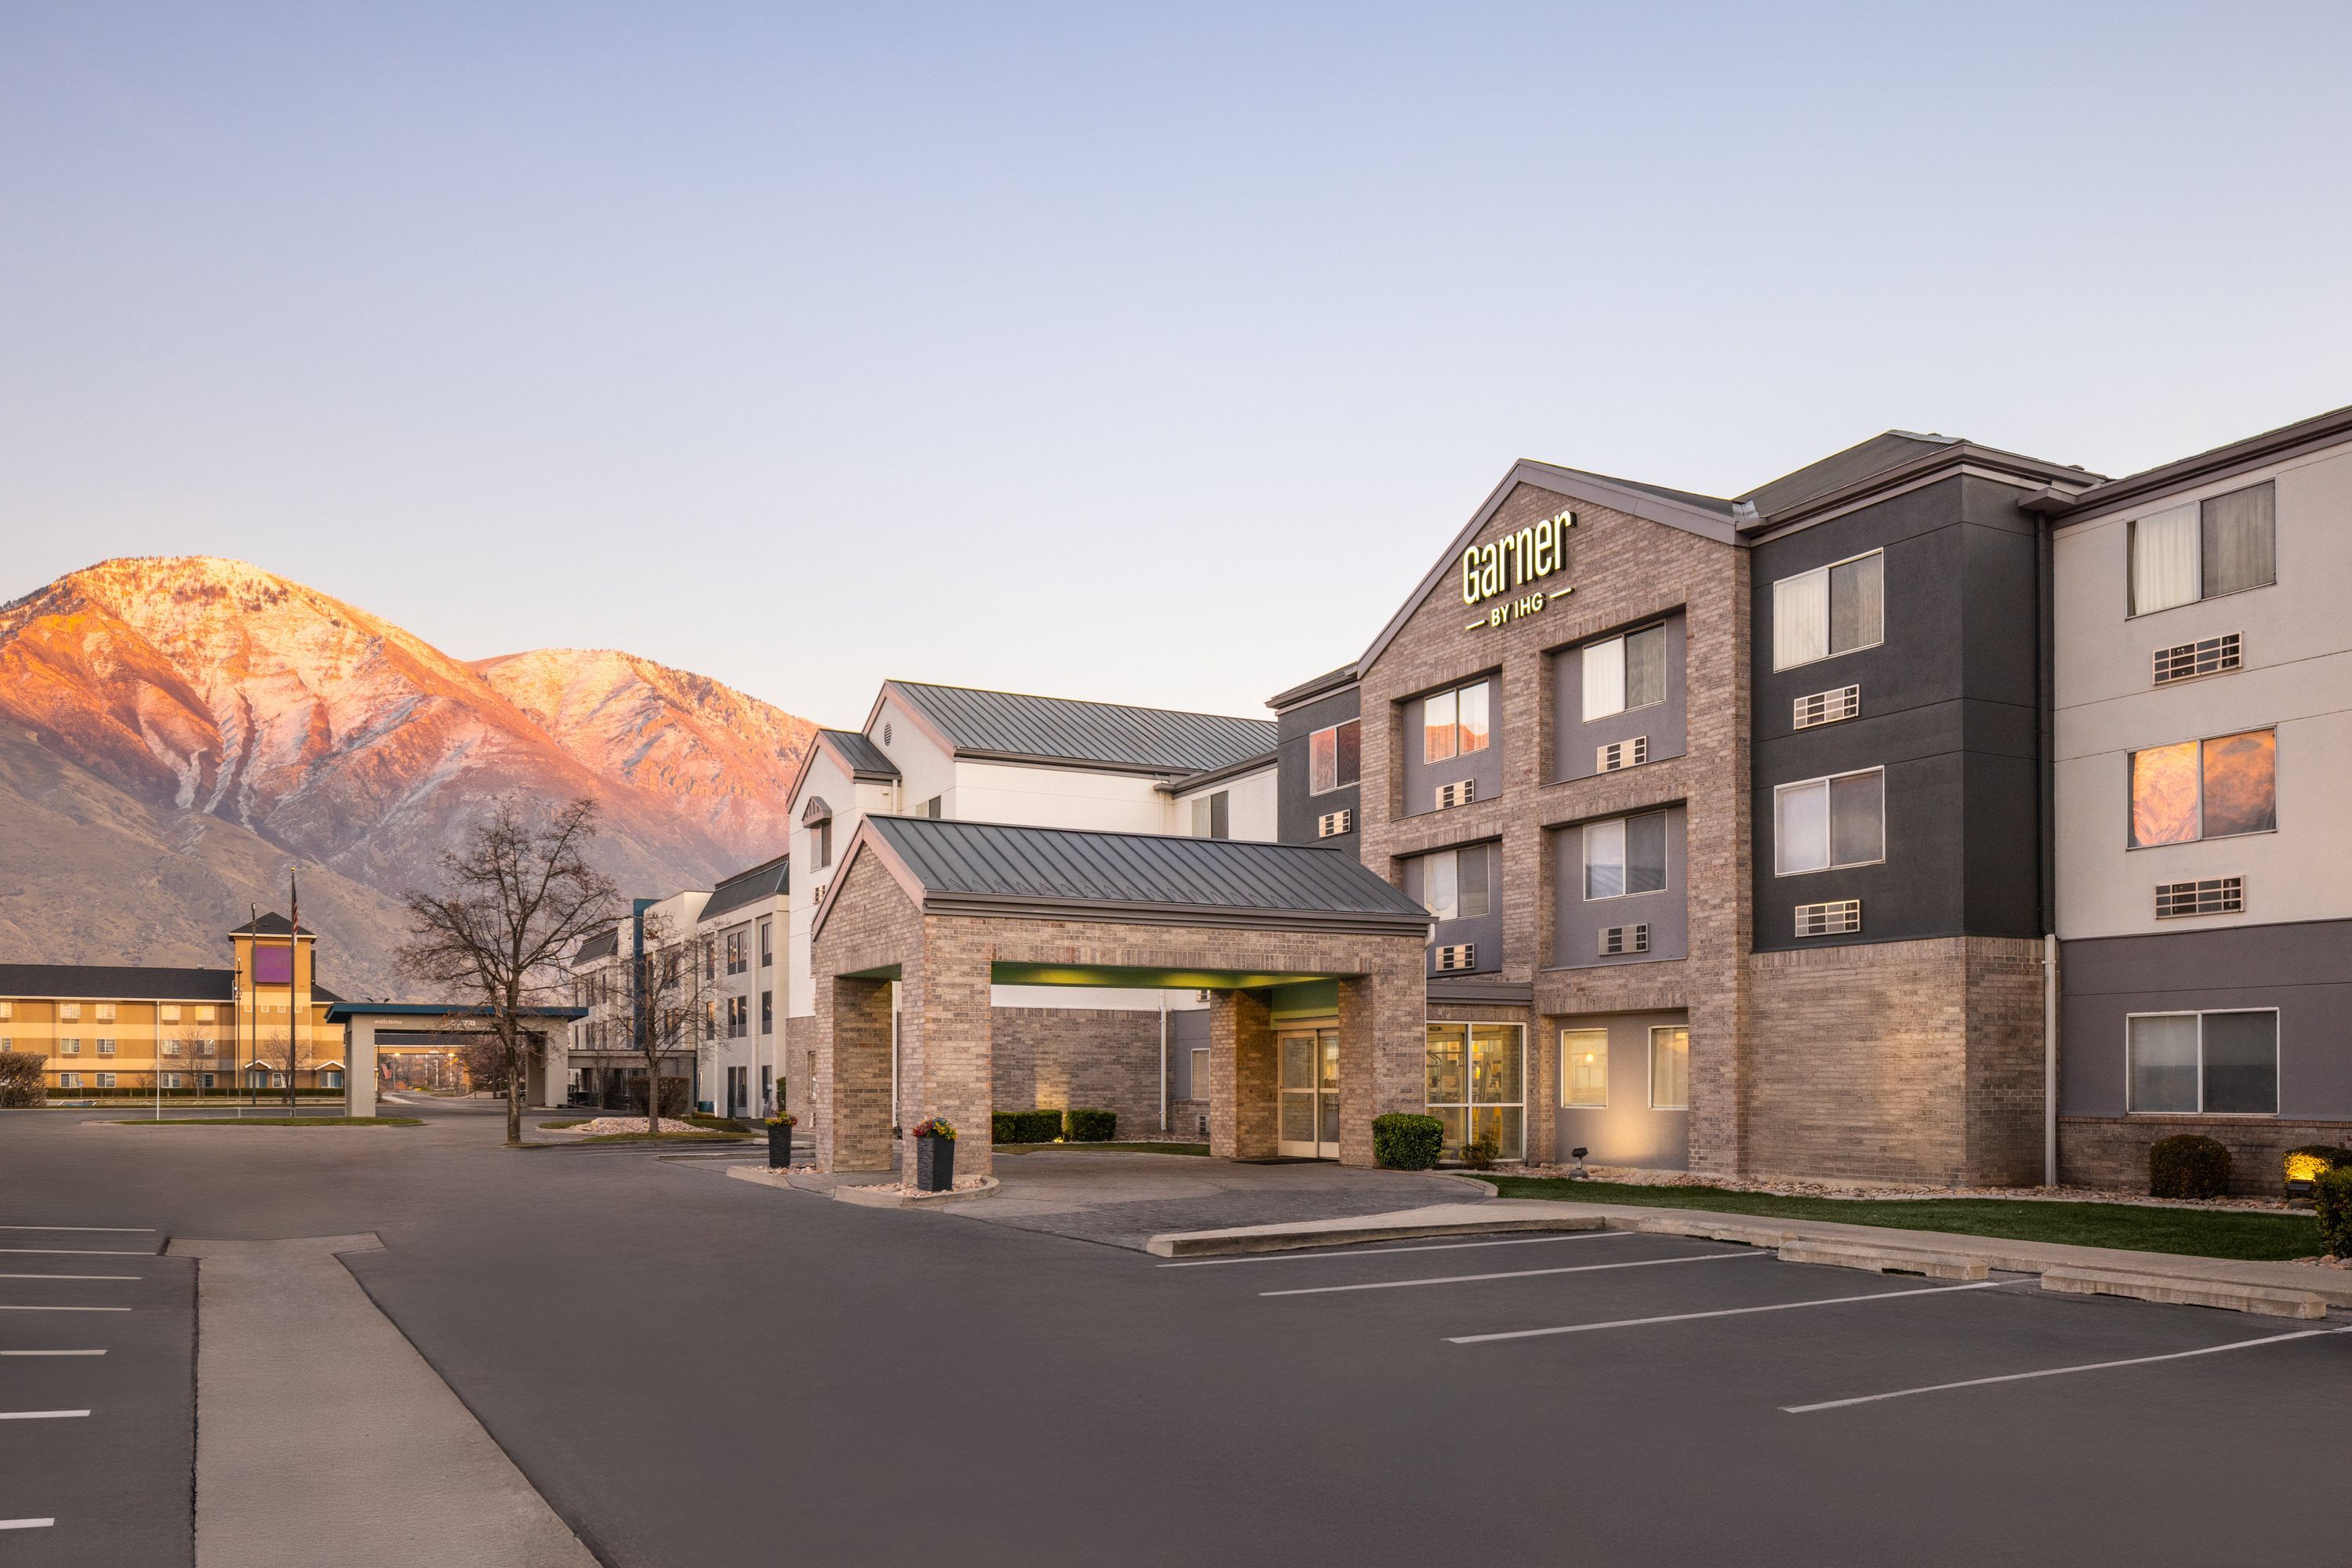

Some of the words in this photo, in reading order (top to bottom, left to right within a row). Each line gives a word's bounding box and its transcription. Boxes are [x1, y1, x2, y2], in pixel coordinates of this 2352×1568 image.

[1463, 510, 1573, 604] Garner
[1491, 603, 1510, 627] BY
[1515, 592, 1544, 619] IHG
